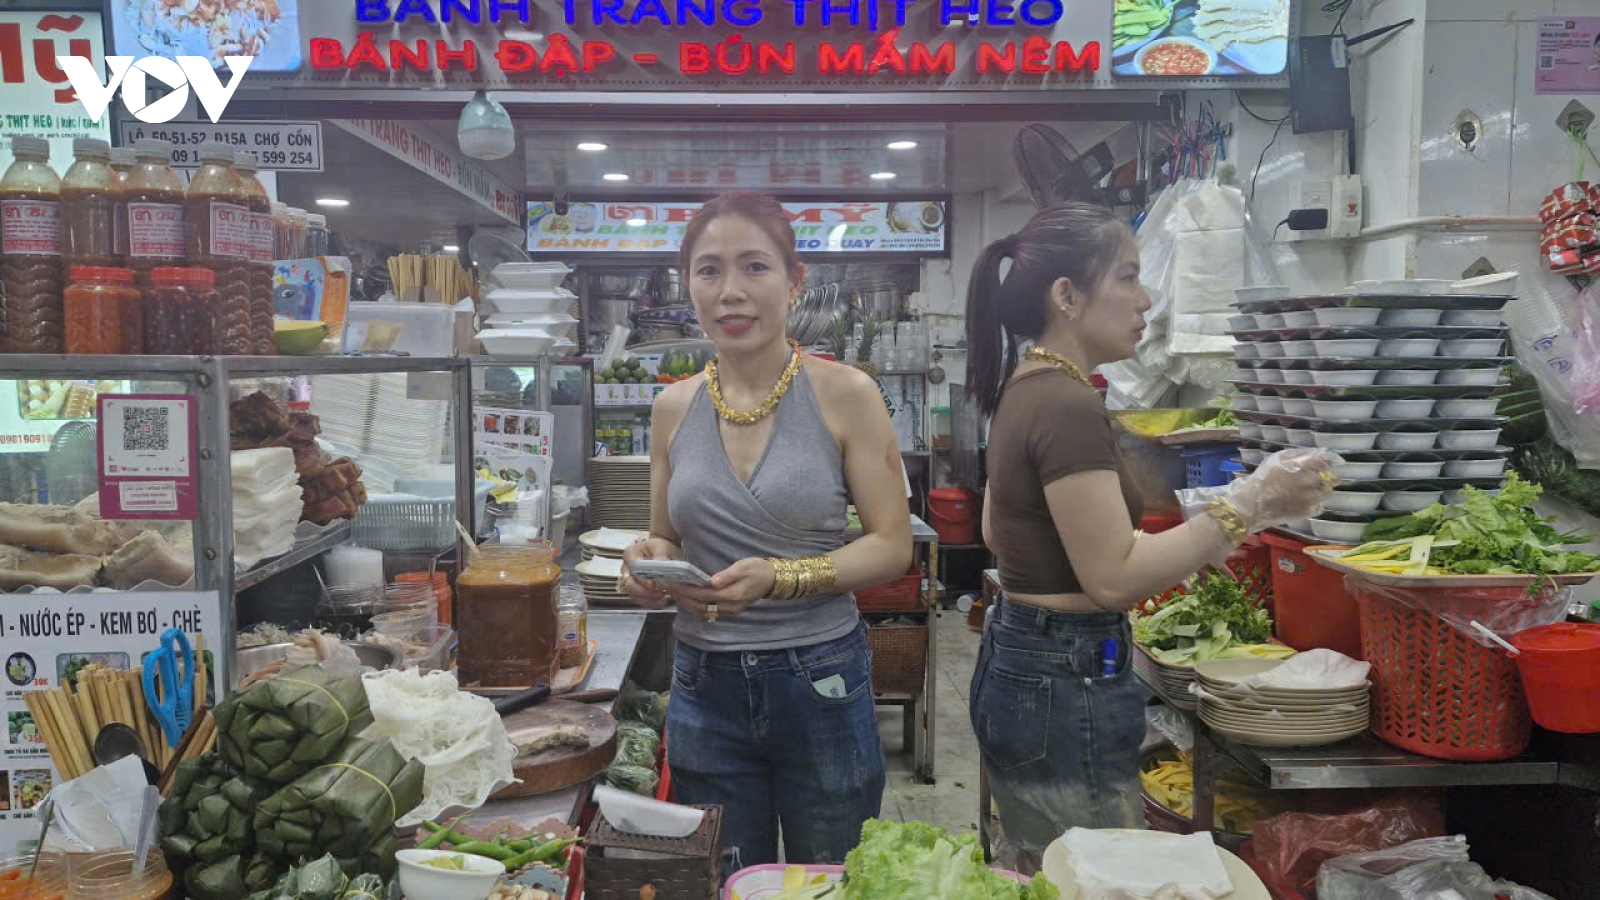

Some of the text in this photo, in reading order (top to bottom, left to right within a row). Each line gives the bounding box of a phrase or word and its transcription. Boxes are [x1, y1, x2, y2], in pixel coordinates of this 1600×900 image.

[310, 32, 476, 71] BÁNH
[496, 34, 615, 77] ĐẬP
[679, 34, 797, 76] BÚN
[818, 28, 956, 75] MẮM
[978, 35, 1101, 75] NÊM
[34, 114, 52, 129] HEO
[254, 131, 280, 151] CHỢ
[263, 152, 286, 164] 599
[289, 153, 312, 164] 254
[797, 239, 821, 248] EO
[19, 609, 62, 637] NƯỚC
[67, 607, 85, 636] ÉP
[100, 611, 132, 635] KEM
[137, 607, 157, 633] BƠ
[172, 605, 202, 633] CHÈ
